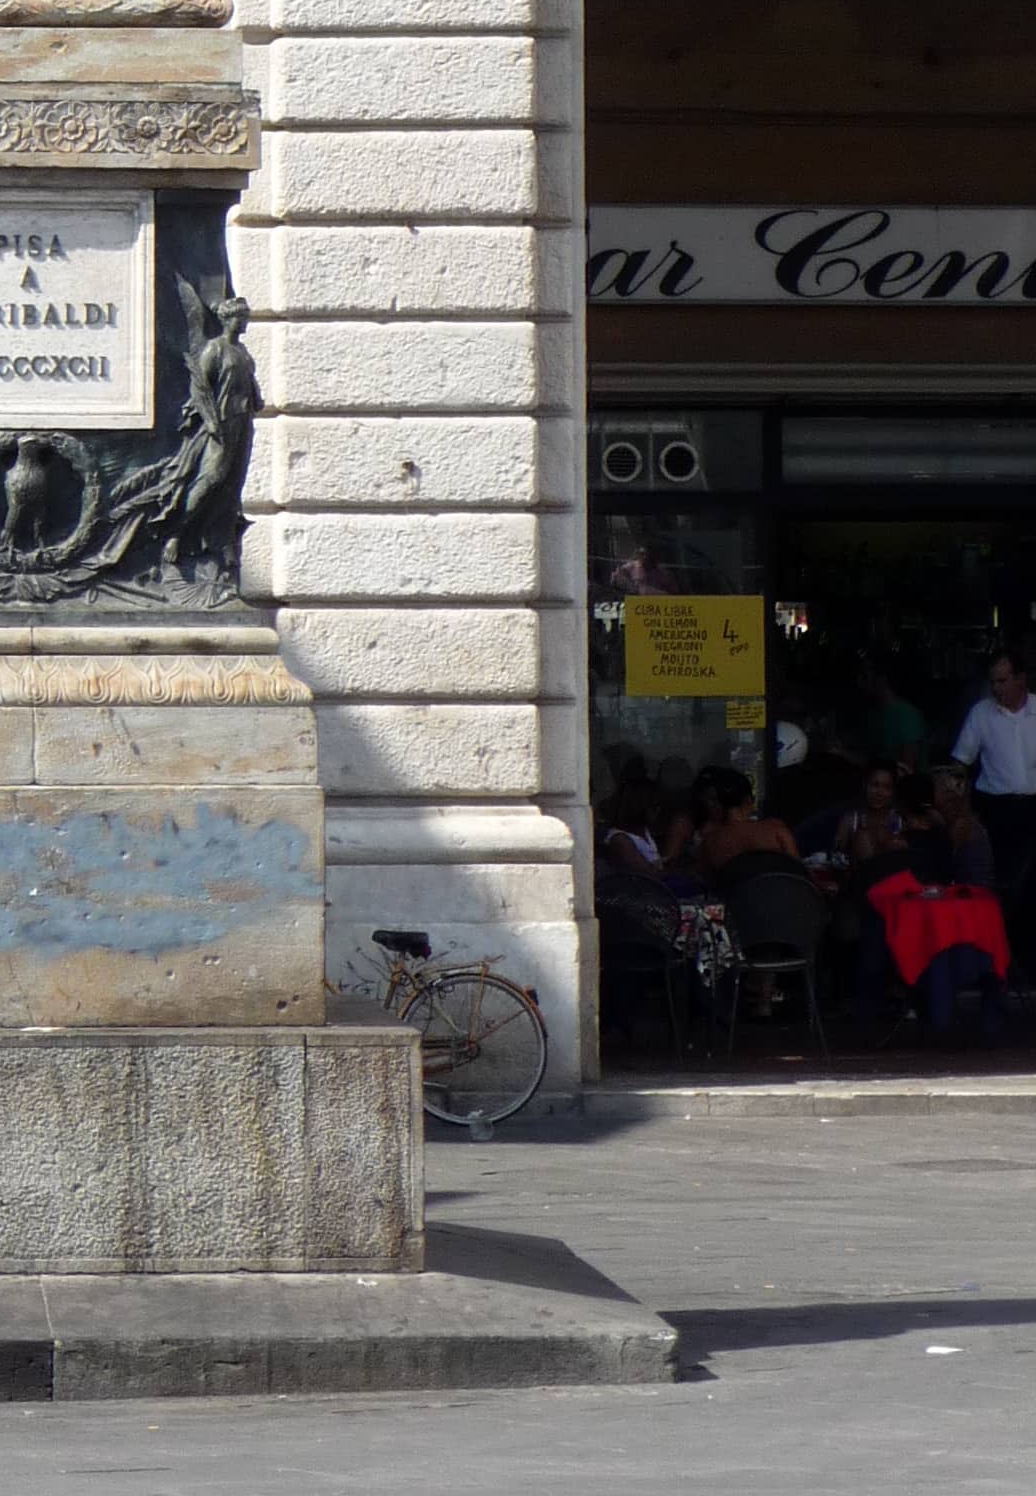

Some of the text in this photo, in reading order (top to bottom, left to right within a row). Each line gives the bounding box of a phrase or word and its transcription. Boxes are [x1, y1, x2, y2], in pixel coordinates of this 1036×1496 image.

[20, 266, 39, 290] A
[634, 605, 694, 617] CUBA LIBRE
[643, 618, 697, 628] GIN LEMON
[649, 630, 707, 640] AMERICANO
[723, 618, 739, 643] 4
[654, 642, 702, 652] NEGRONI
